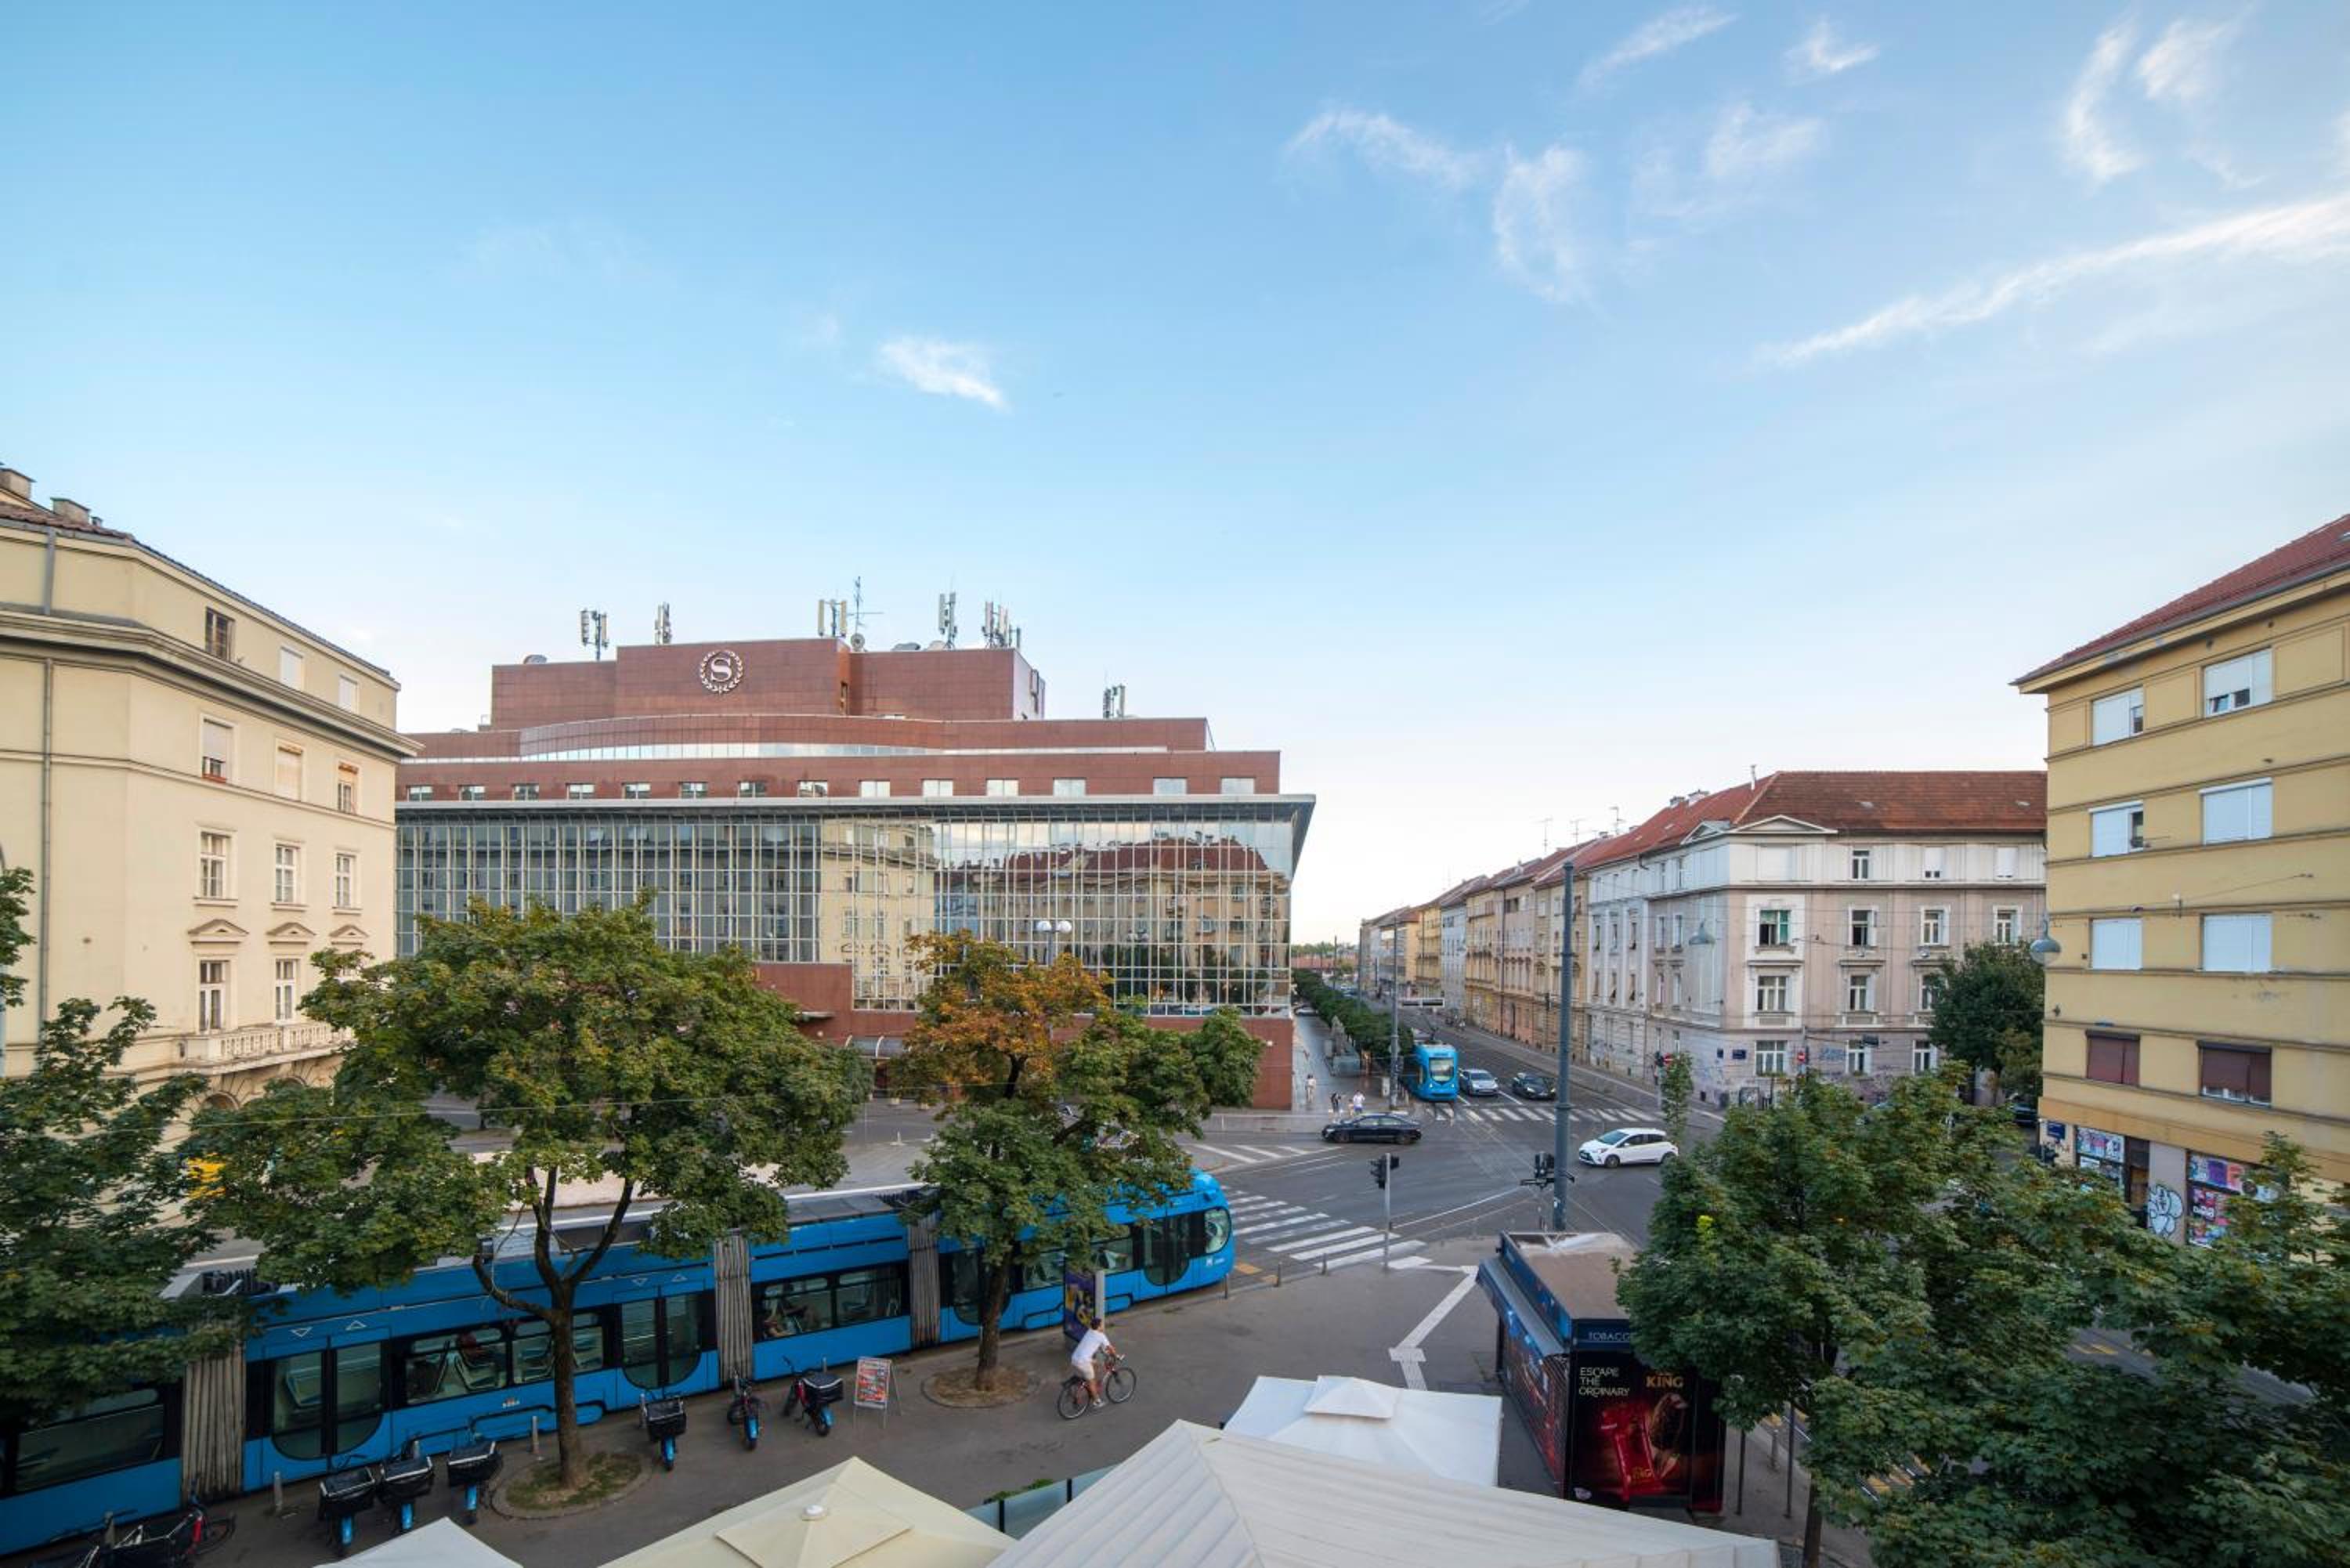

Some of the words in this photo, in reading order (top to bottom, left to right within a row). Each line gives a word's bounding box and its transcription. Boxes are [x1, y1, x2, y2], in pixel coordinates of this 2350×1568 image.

[710, 657, 732, 682] S
[1589, 1332, 1632, 1342] TOBACC
[1580, 1367, 1619, 1377] ESCAPE
[1580, 1377, 1600, 1386] THE
[1646, 1376, 1683, 1387] KING
[1578, 1387, 1630, 1397] ORDINARY
